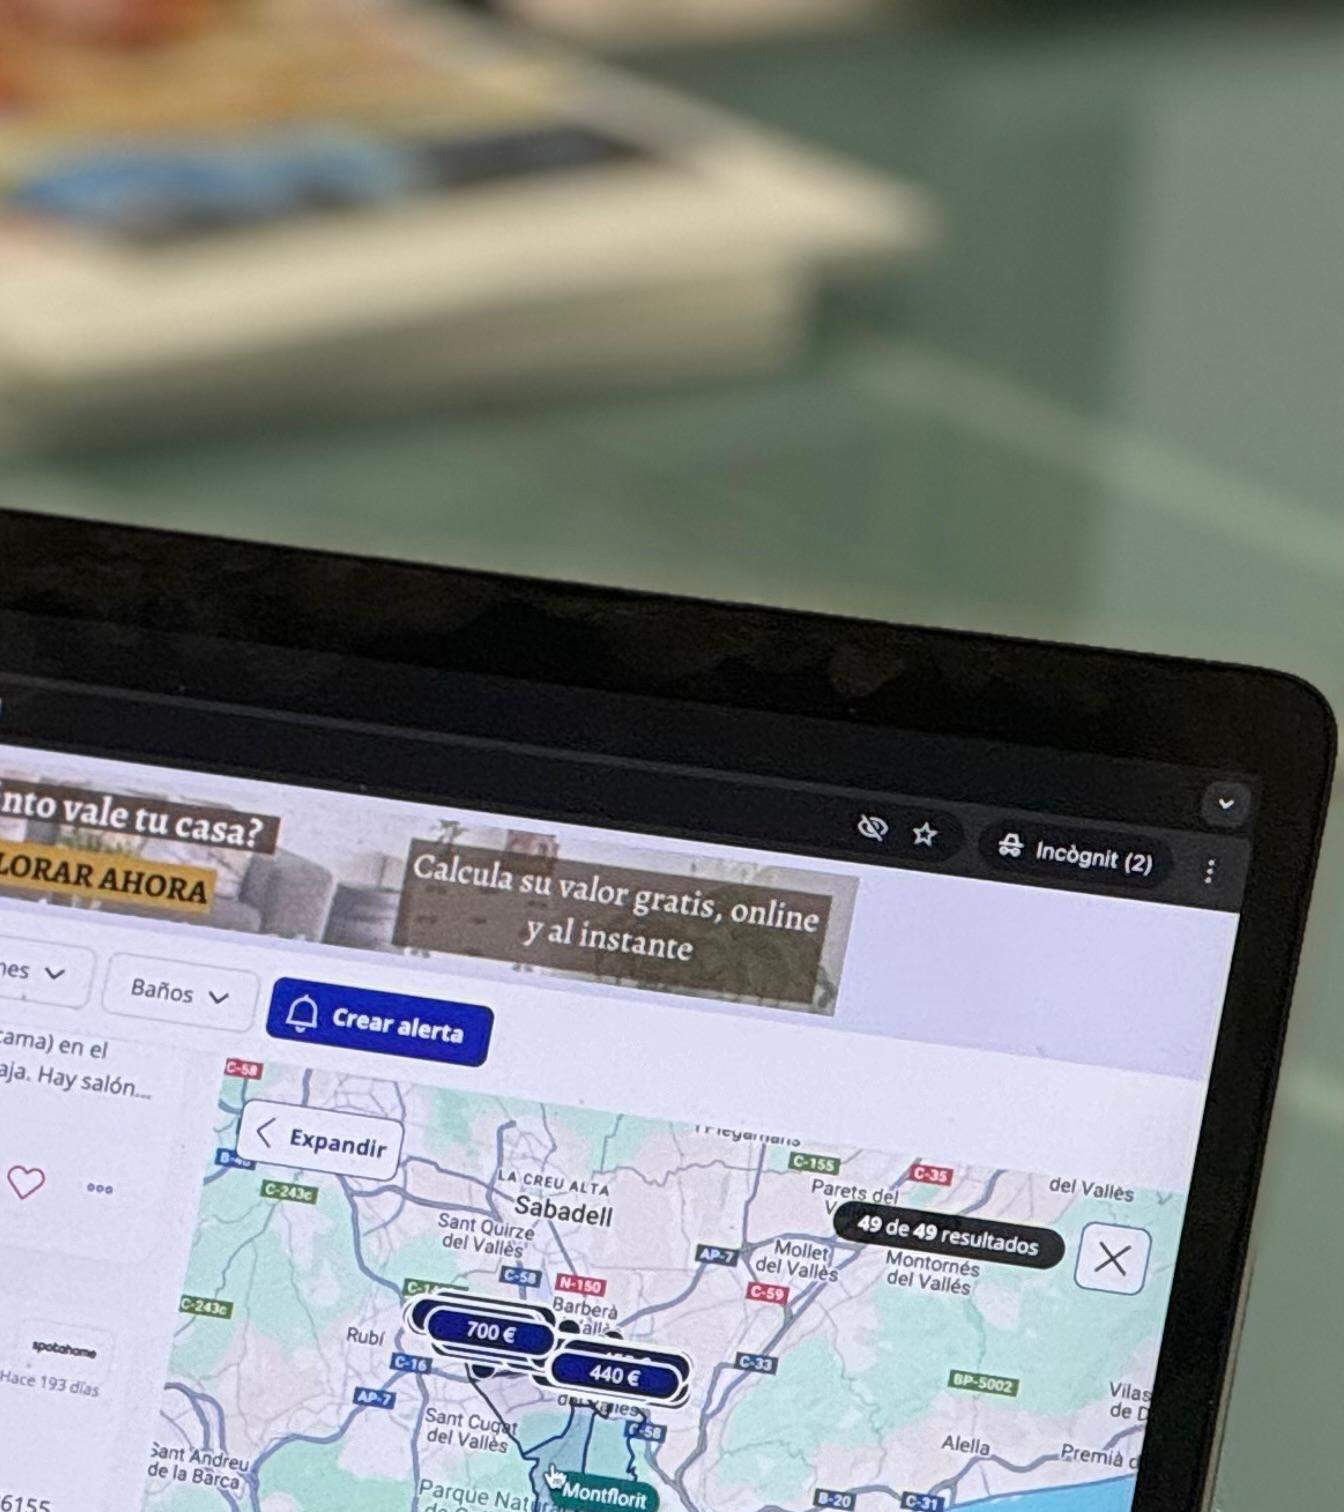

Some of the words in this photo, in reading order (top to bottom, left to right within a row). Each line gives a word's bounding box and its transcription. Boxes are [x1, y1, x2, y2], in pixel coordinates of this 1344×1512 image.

[62, 795, 129, 829] vale
[134, 807, 169, 835] tu
[173, 815, 264, 848] casa?
[1035, 840, 1119, 869] Incògnit
[1123, 851, 1153, 876] (2)
[97, 866, 208, 905] AHORA
[412, 852, 513, 891] Calcula
[517, 873, 552, 897] su
[558, 873, 630, 906] valor
[631, 889, 722, 923] gratis,
[729, 898, 820, 933] online
[521, 919, 545, 947] y
[546, 916, 575, 945] al
[577, 919, 694, 961] instante
[129, 976, 194, 1004] Baños
[331, 1006, 395, 1033] Crear
[396, 1016, 464, 1044] alerta
[57, 1038, 84, 1056] en
[88, 1040, 109, 1059] el
[36, 1064, 78, 1092] Hay
[289, 1127, 387, 1159] Expandir
[496, 1167, 517, 1183] LA
[522, 1171, 565, 1190] CREU
[567, 1179, 609, 1197] ALTA
[513, 1193, 613, 1227] Sabadell
[856, 1213, 883, 1233] 49
[884, 1217, 910, 1237] de
[911, 1221, 938, 1241] 49
[940, 1229, 1039, 1256] resultados
[556, 1275, 602, 1298] N-150
[885, 1268, 914, 1287] del
[749, 1284, 785, 1301] C-59
[466, 1319, 500, 1341] 700
[501, 1325, 517, 1344] €
[31, 1340, 97, 1359] spotahome
[40, 1374, 67, 1392] 193
[68, 1379, 99, 1398] días
[588, 1363, 624, 1385] 440
[625, 1368, 641, 1387] €
[356, 1389, 392, 1405] AP-7
[939, 1433, 991, 1457] Alella
[561, 1478, 648, 1510] Montflorit
